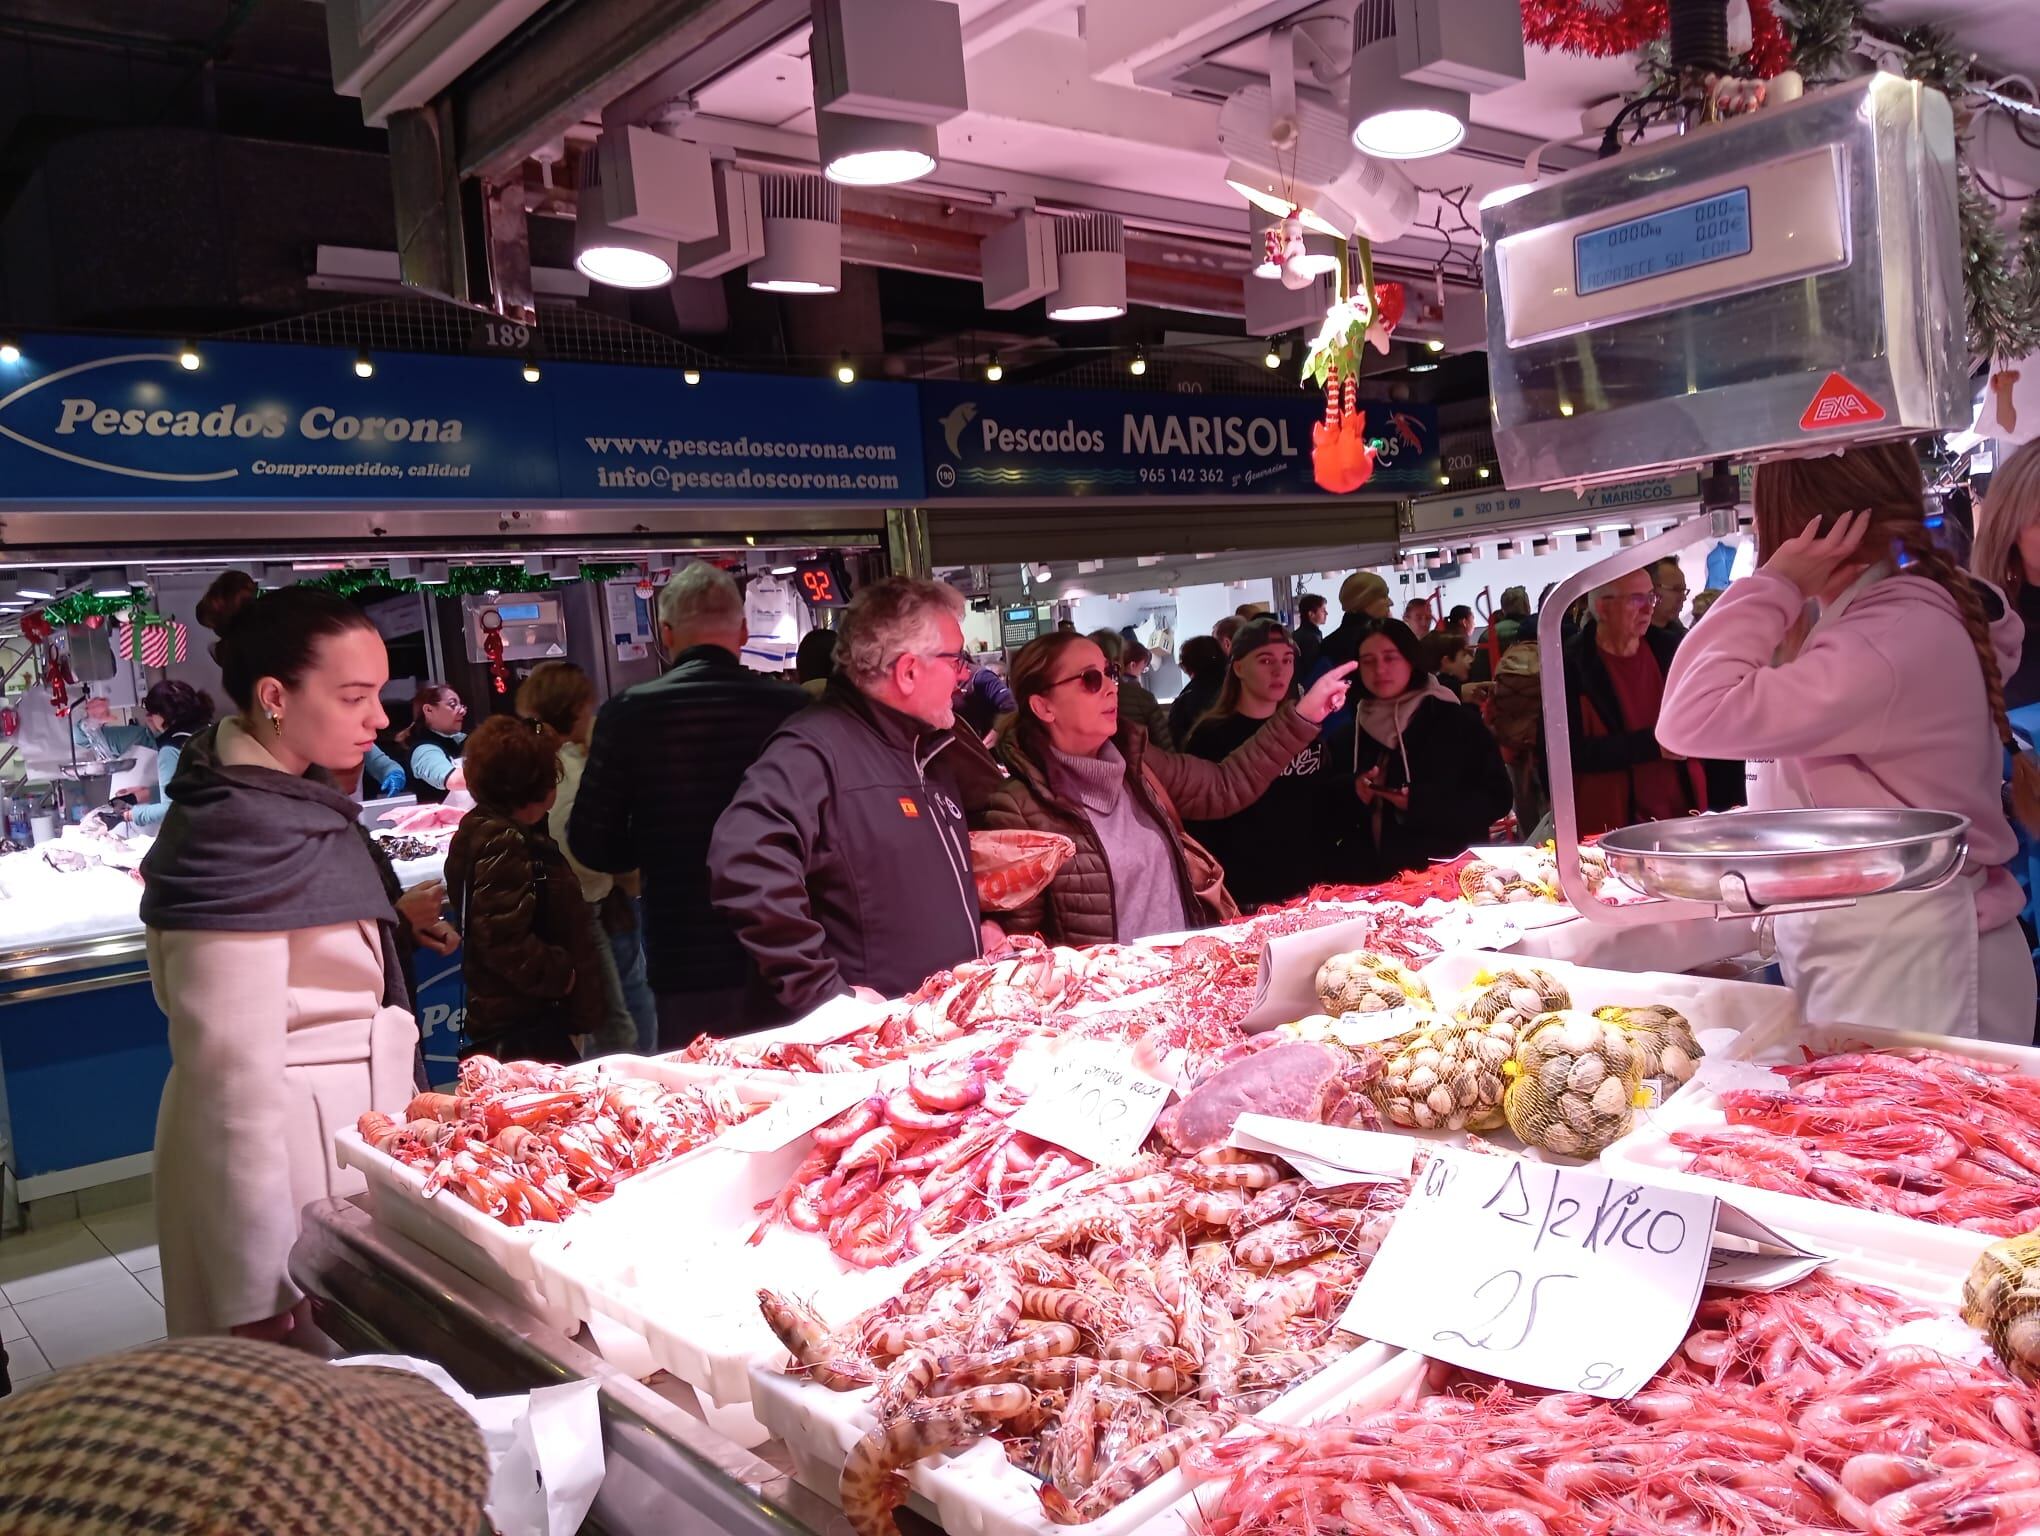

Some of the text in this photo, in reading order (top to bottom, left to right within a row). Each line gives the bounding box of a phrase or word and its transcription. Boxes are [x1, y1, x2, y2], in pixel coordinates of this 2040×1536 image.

[485, 322, 531, 349] 189
[1813, 394, 1868, 421] EXA
[55, 399, 463, 444] Pescados Corona
[981, 414, 1298, 456] Pescados MARISOL
[584, 436, 897, 461] www.pescadoscorona.com
[251, 460, 471, 480] Comprometidos, calidad
[1139, 468, 1166, 483] 965
[1171, 468, 1195, 482] 142
[1200, 469, 1224, 483] 362
[1448, 454, 1473, 471] 200
[597, 466, 899, 491] info@pescadoscorona.com
[1587, 484, 1673, 507] Y MARISCOS
[803, 570, 833, 601] 92
[1432, 1269, 1579, 1351] 25
